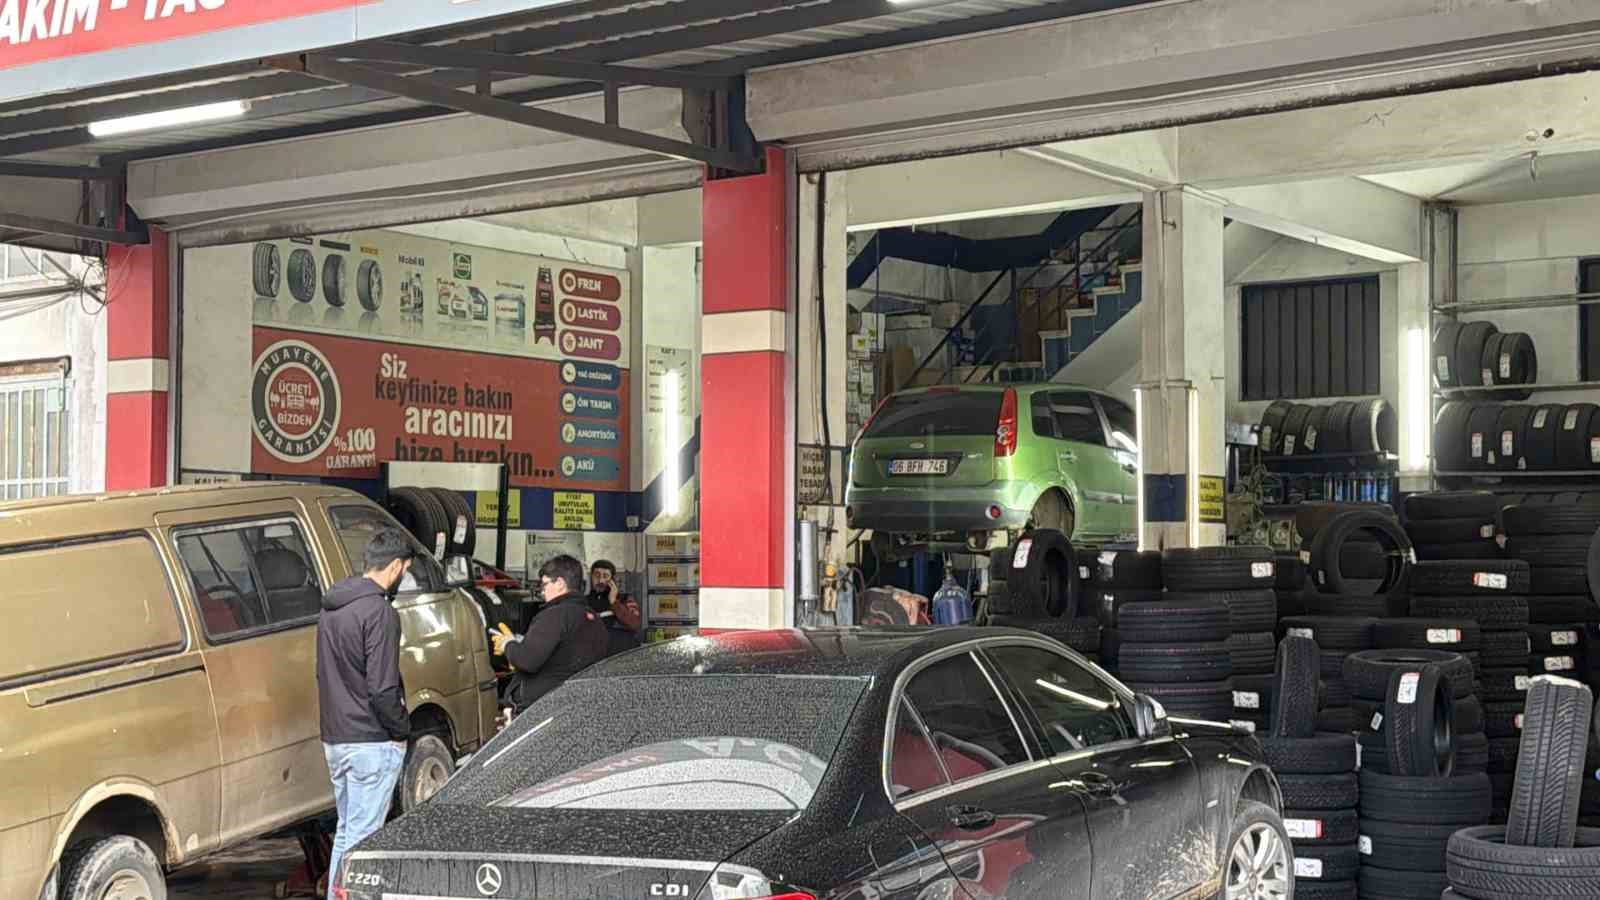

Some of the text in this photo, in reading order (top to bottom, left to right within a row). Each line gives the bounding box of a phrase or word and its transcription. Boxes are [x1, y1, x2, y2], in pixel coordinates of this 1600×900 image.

[577, 278, 602, 292] FREN
[577, 306, 608, 321] LASTİK
[577, 336, 604, 350] JANT
[260, 347, 329, 381] MUAYENE
[381, 352, 408, 379] Siz
[375, 374, 513, 409] keyfinize bakın
[405, 406, 513, 441] aracınızı
[334, 427, 376, 452] %100
[650, 883, 689, 897] CDI
